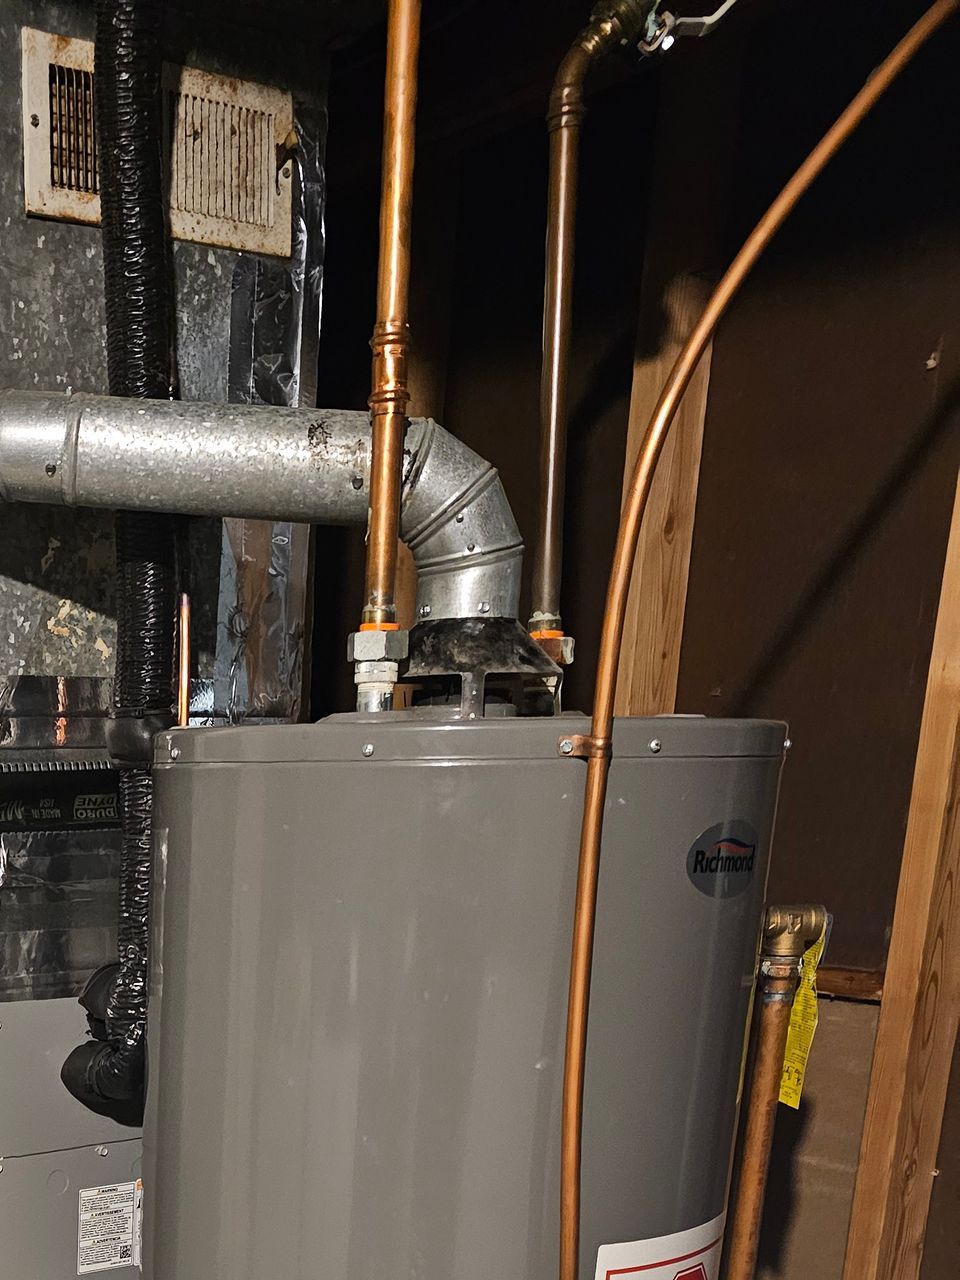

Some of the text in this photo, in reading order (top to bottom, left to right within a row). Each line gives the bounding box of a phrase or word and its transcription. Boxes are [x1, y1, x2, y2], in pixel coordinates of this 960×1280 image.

[76, 797, 114, 807] DYNE
[77, 808, 114, 818] DURO
[693, 844, 755, 873] Richmond
